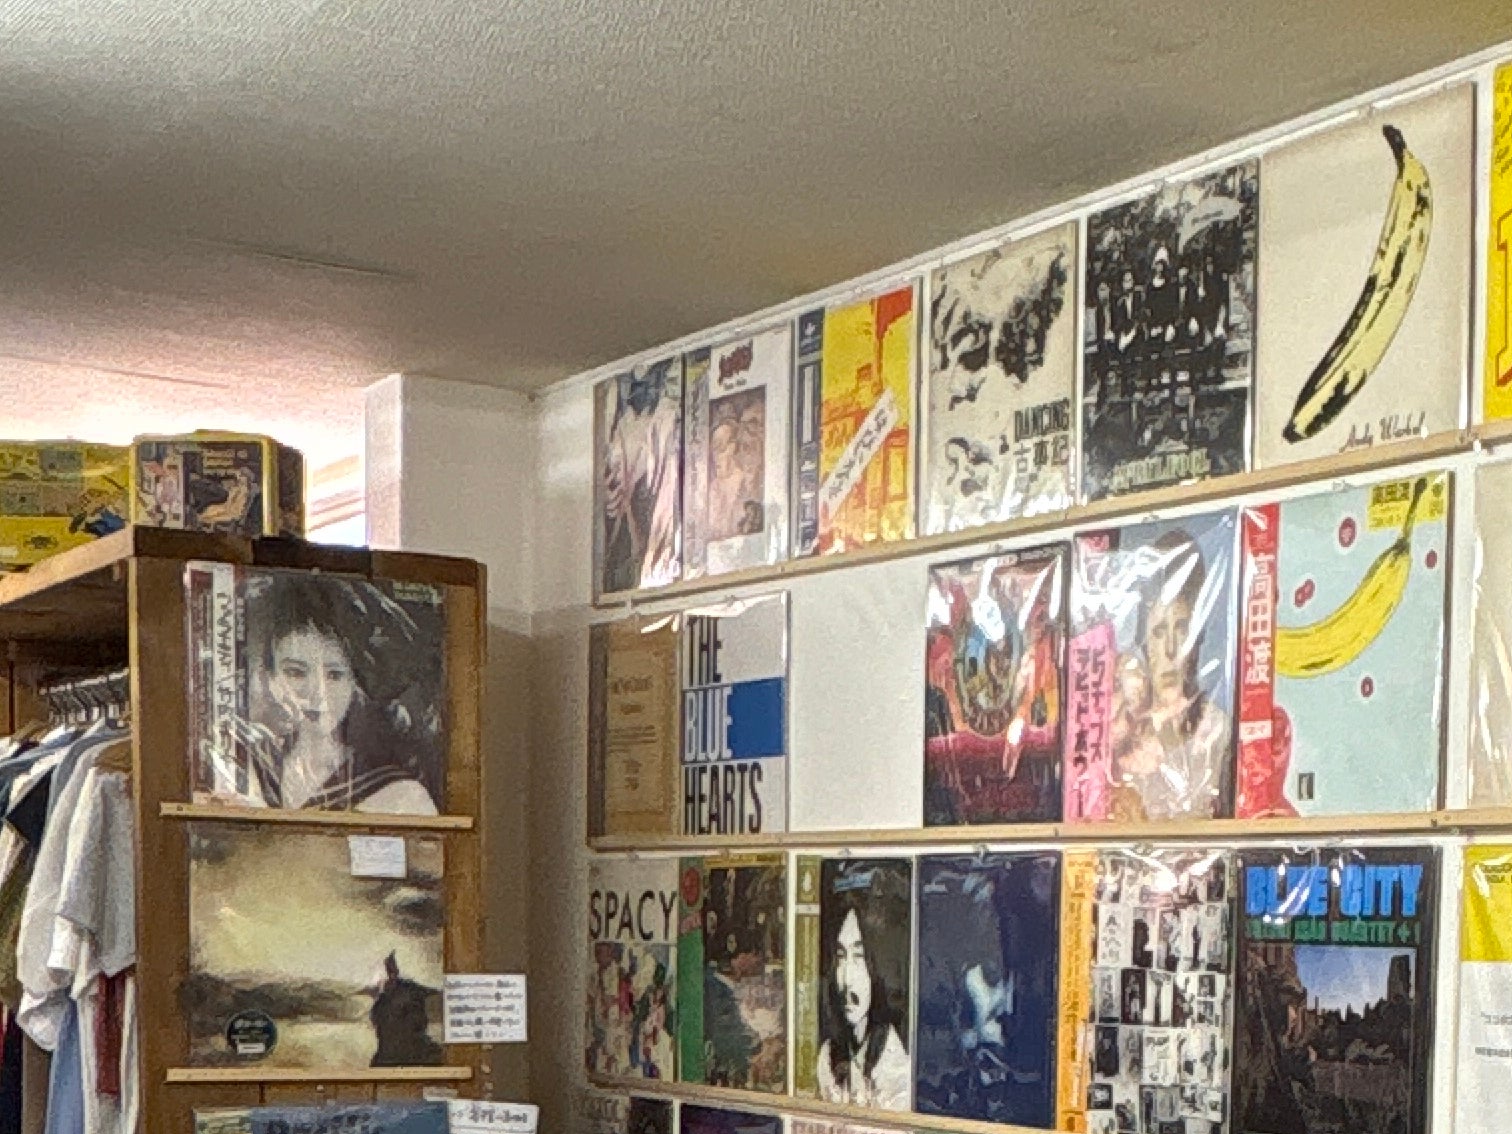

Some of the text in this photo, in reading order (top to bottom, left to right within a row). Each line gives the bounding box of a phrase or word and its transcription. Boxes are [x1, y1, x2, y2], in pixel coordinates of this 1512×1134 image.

[687, 616, 722, 687] THE
[685, 687, 732, 762] BLUE
[685, 763, 764, 836] HEARTS
[589, 889, 678, 941] SPACY
[1340, 864, 1424, 917] CITY
